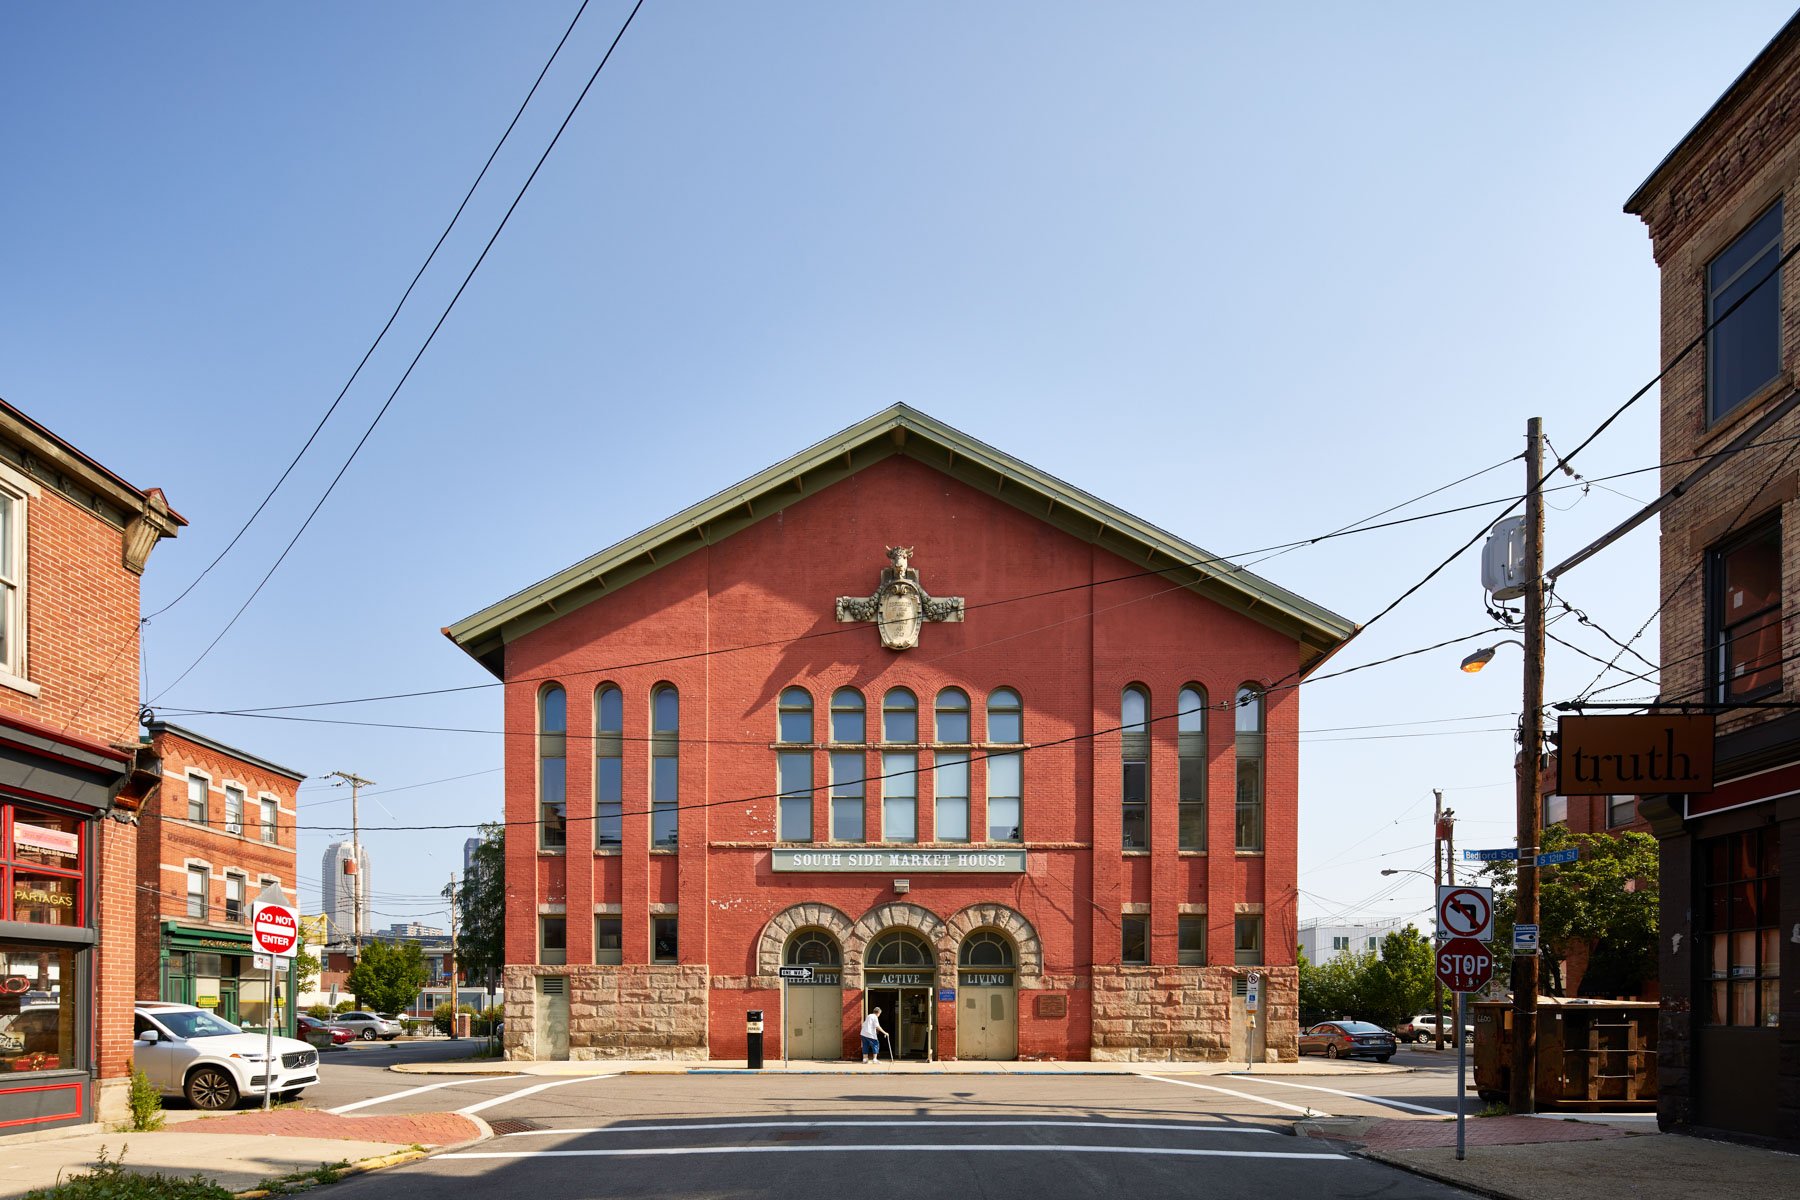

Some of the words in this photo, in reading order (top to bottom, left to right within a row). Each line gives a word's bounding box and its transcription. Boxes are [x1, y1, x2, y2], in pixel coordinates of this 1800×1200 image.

[1572, 728, 1700, 781] truth.
[793, 854, 841, 866] SOUTH
[848, 854, 882, 866] SIDE
[889, 854, 951, 866] MARKET
[958, 854, 1006, 866] HOUSE
[1465, 850, 1497, 860] Bedford
[1501, 850, 1514, 859] Sq
[1541, 856, 1546, 864] S
[1549, 854, 1564, 863] 12th
[1567, 851, 1575, 860] St
[15, 890, 73, 906] PARTAGAS
[260, 912, 273, 922] DO
[275, 915, 292, 926] NOT
[261, 934, 289, 946] ENTER
[1440, 954, 1489, 975] STOP
[881, 974, 920, 983] ACTIVE
[967, 974, 1005, 983] LIVING
